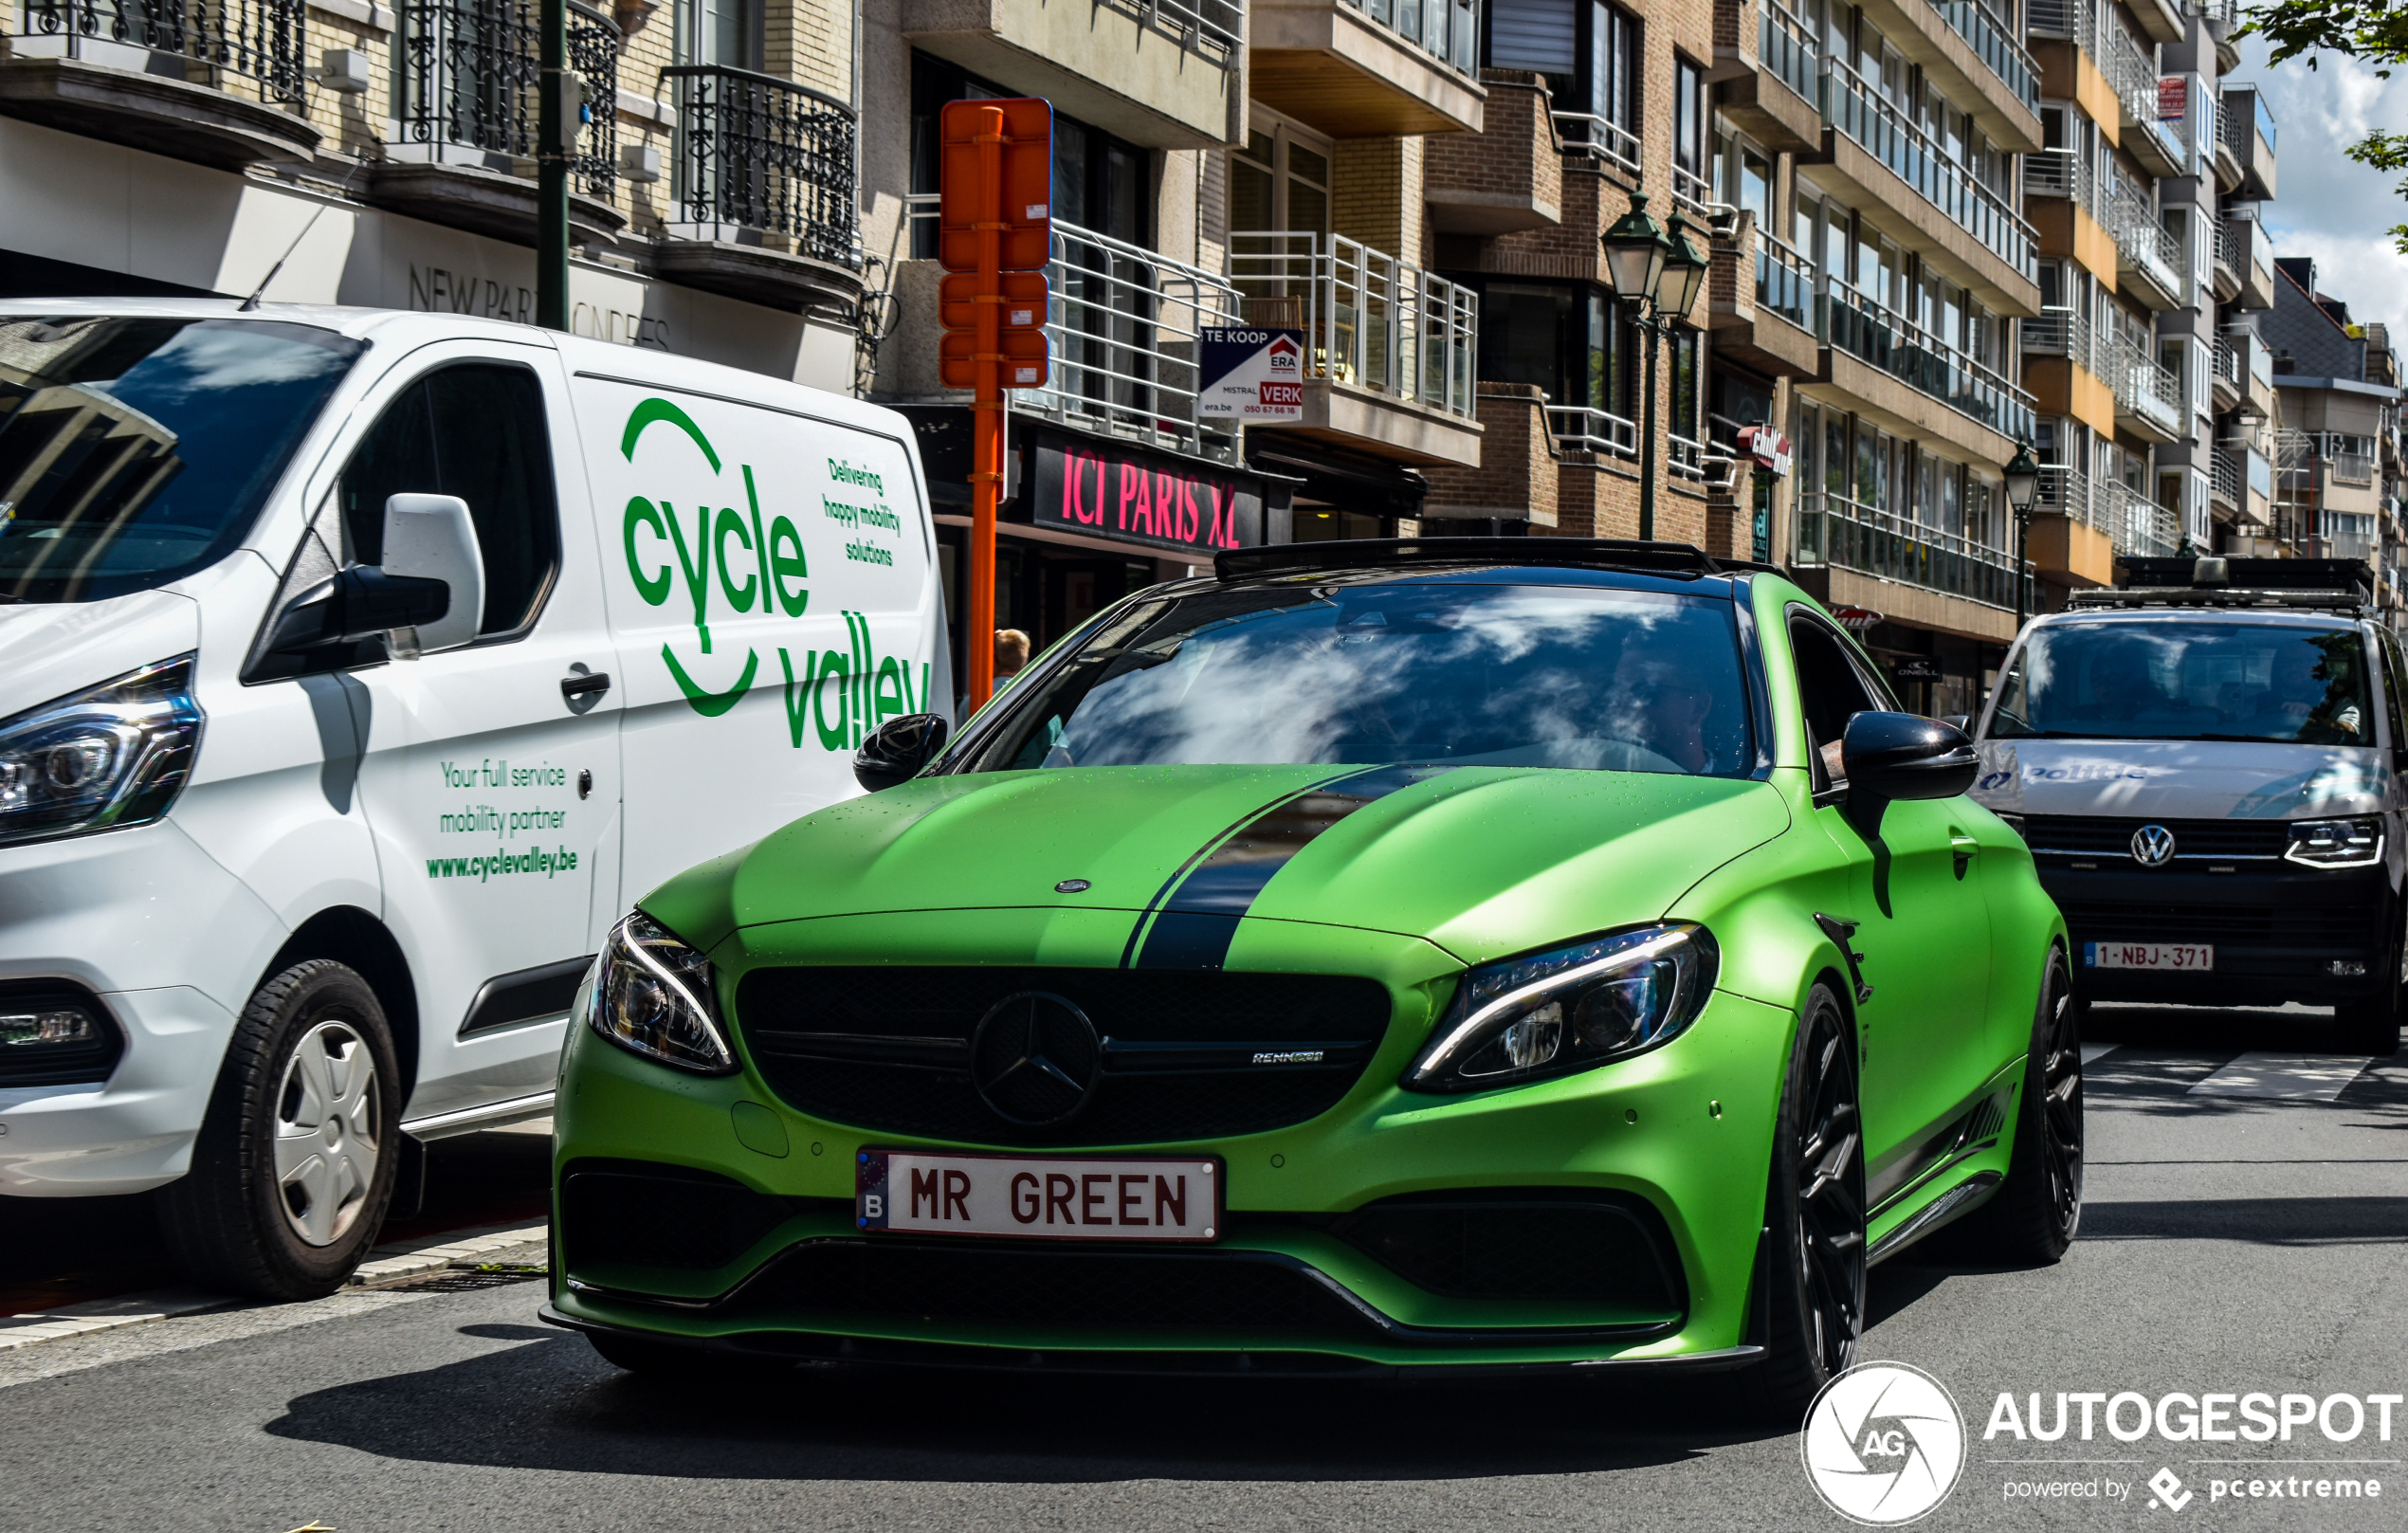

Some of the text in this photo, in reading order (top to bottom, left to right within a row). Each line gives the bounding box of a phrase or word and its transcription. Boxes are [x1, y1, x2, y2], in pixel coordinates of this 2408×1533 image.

[483, 279, 538, 325] PAR
[1206, 330, 1268, 344] TE KOOP
[1271, 356, 1296, 368] ERA
[1223, 387, 1257, 395] MISTRAL
[1262, 386, 1302, 403] VERK
[828, 457, 884, 498] Delivering
[1062, 446, 1240, 550] ICI PARIS XL
[822, 493, 901, 538] happy mobility
[623, 464, 809, 654] cycle
[846, 537, 893, 567] solutions
[441, 758, 566, 788] Your full service
[2027, 764, 2148, 781] Politie
[441, 805, 567, 839] mobility partner
[427, 845, 577, 883] www.cyclevalley.be
[2100, 946, 2208, 966] 1-NBJ-371
[865, 1168, 1186, 1226] B MR GREEN
